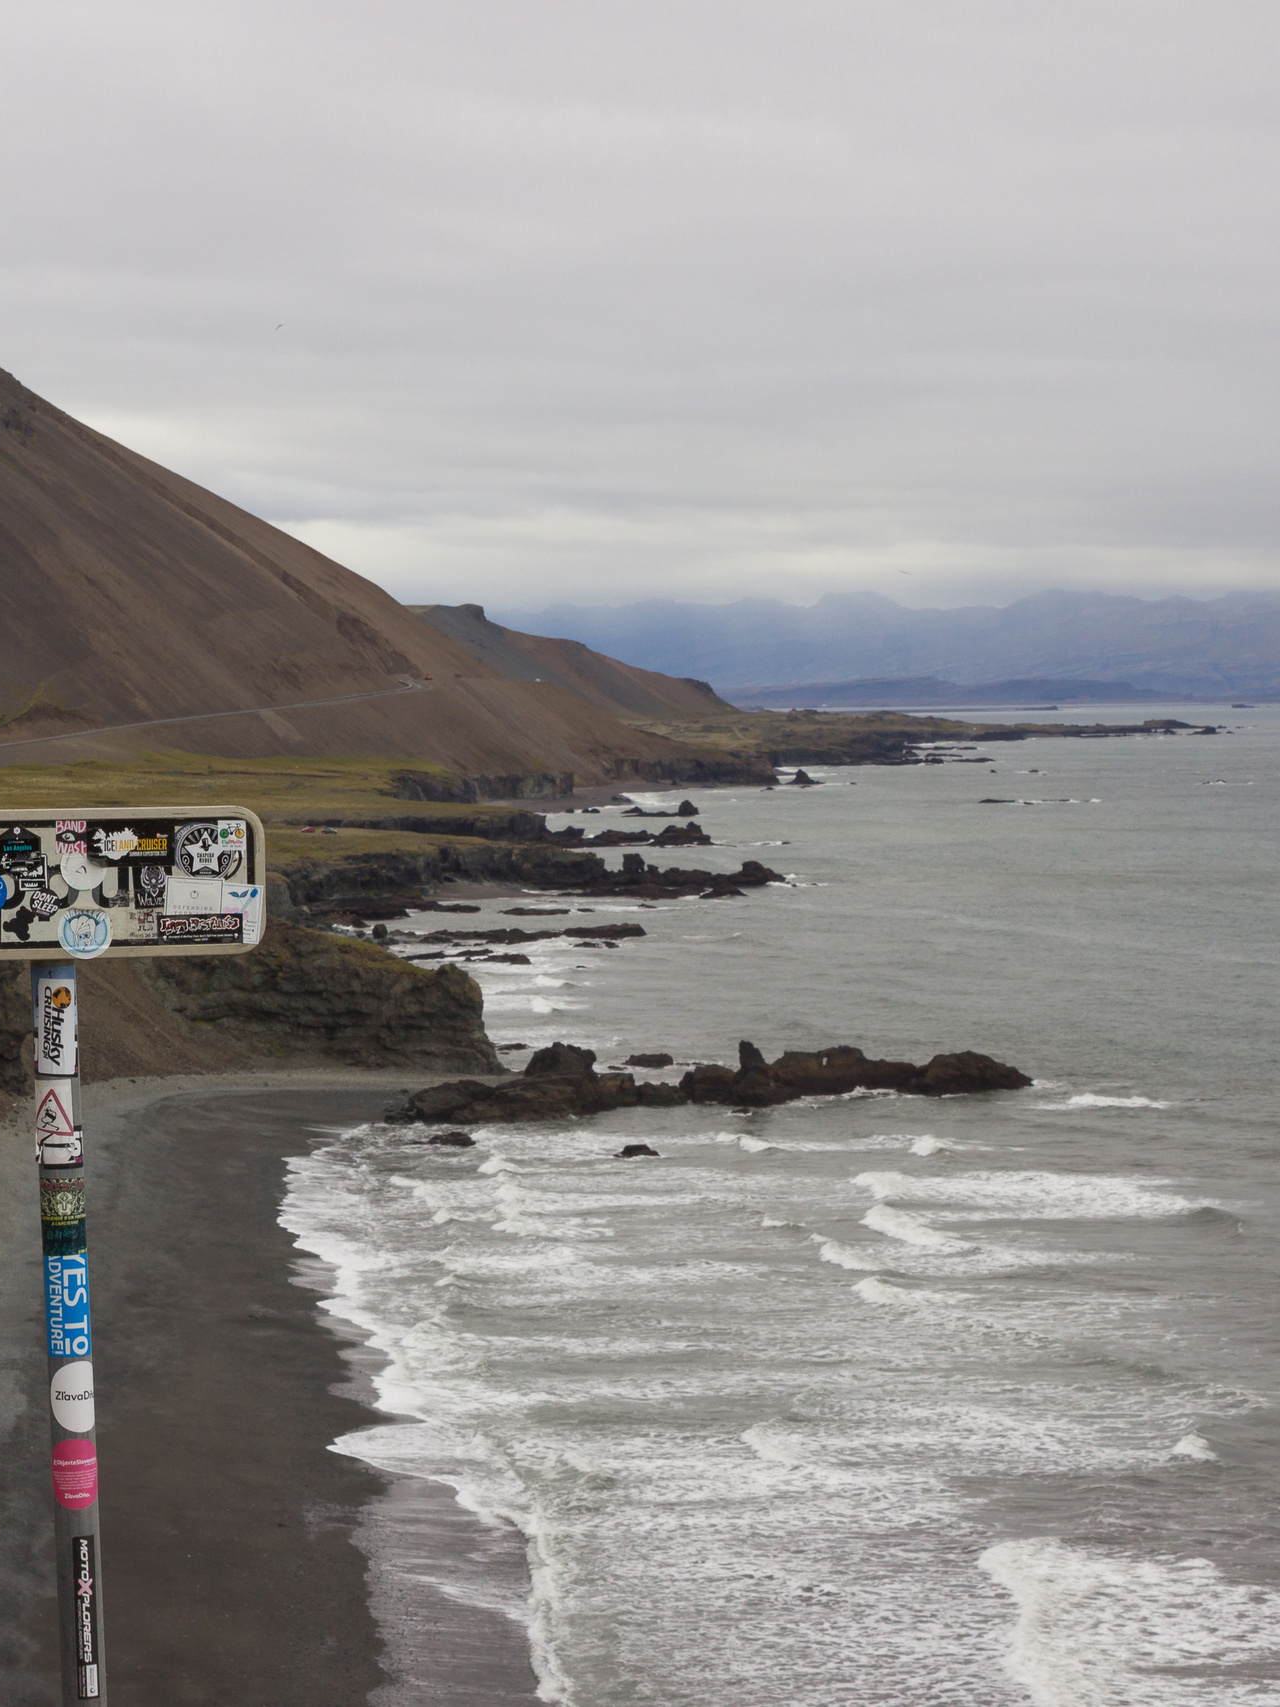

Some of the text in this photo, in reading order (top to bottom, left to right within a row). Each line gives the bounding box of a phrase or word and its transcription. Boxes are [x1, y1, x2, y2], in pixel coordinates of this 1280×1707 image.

[56, 821, 87, 833] BAND
[3, 844, 32, 852] Los Angeles
[103, 838, 168, 852] ICELAND CRUISER
[32, 890, 59, 904] DONT
[32, 899, 59, 914] SLEEP
[51, 1006, 65, 1067] Husky
[48, 1255, 64, 1355] ADVENTURE!
[63, 1254, 89, 1355] YES TO
[77, 1538, 93, 1663] MOTOXPLORERS
